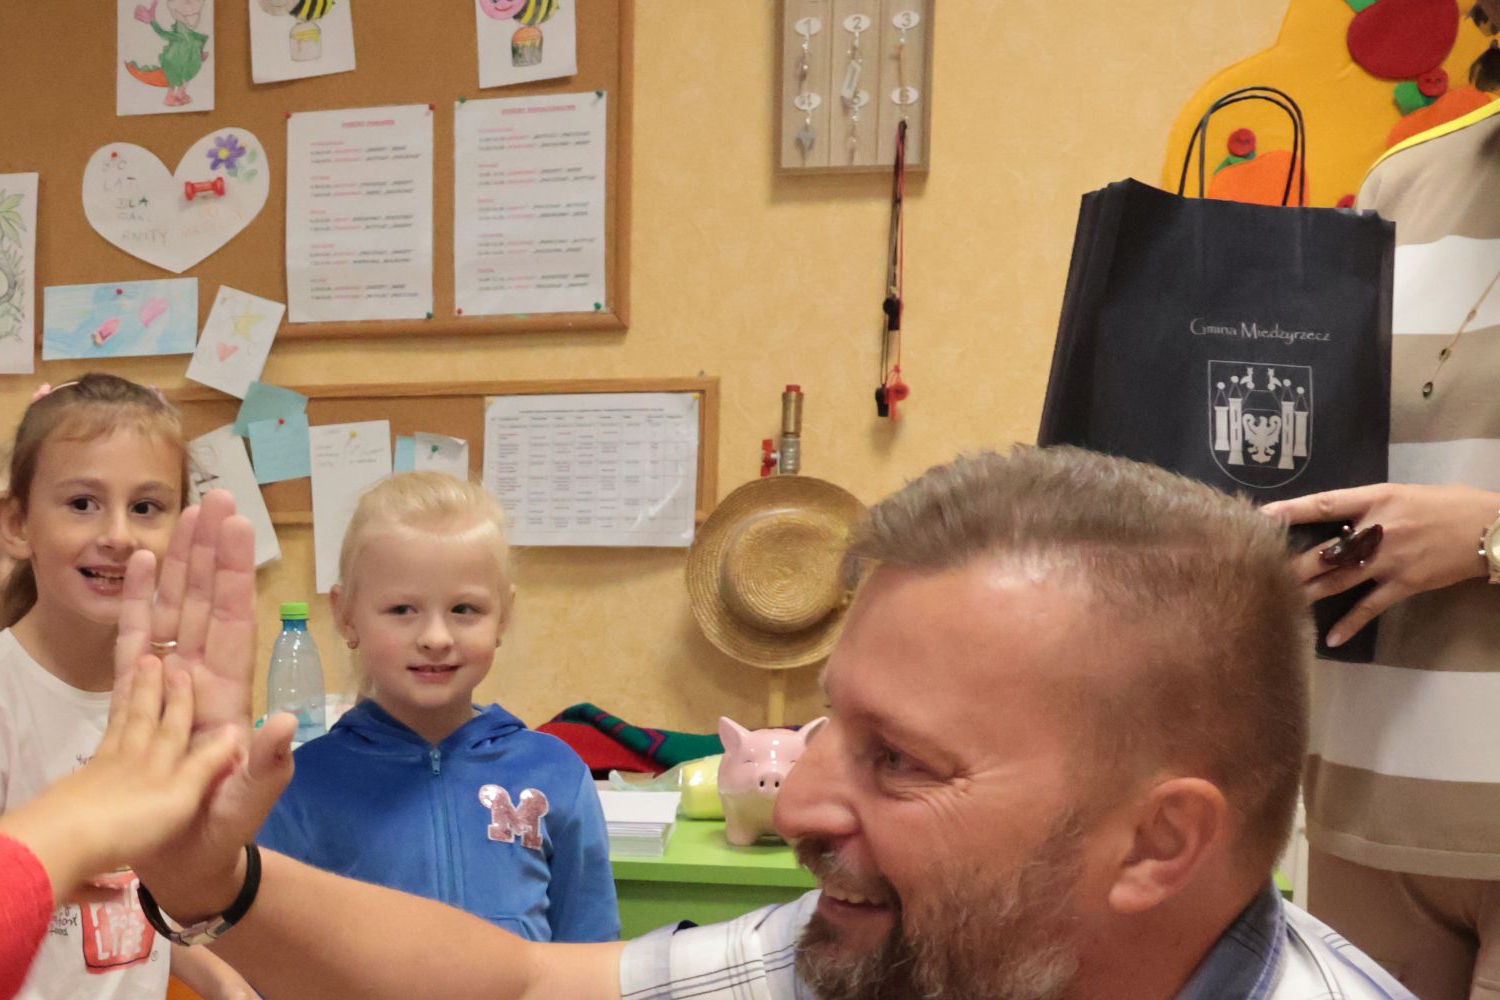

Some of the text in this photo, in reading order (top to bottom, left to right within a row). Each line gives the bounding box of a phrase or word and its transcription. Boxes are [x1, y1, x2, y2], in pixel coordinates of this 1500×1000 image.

[852, 15, 863, 30] 2
[900, 11, 912, 28] 3
[1189, 317, 1237, 336] Gmina
[478, 784, 549, 851] M
